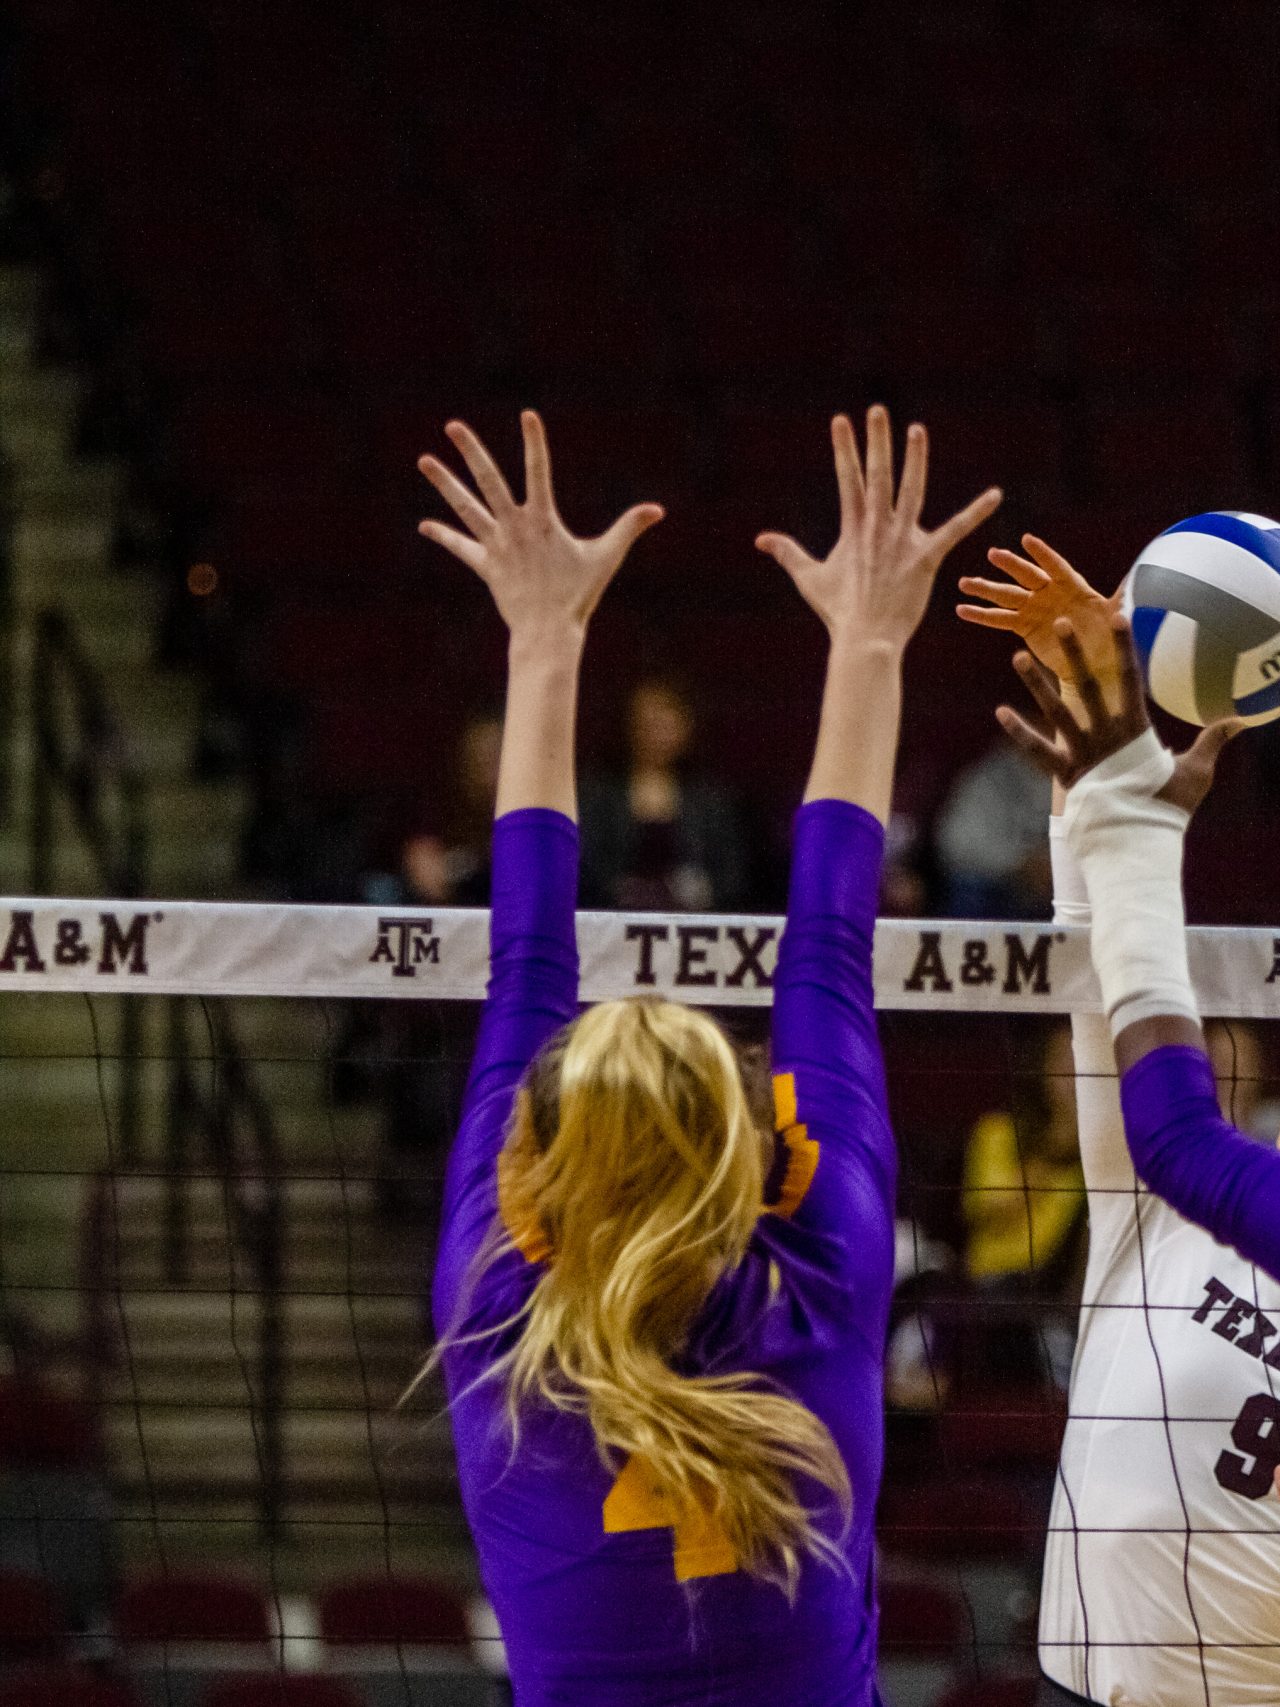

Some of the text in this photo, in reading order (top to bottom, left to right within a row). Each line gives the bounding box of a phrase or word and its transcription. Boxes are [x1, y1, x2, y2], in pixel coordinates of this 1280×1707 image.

[0, 910, 149, 975] A&M
[624, 924, 1053, 994] TEX A&M
